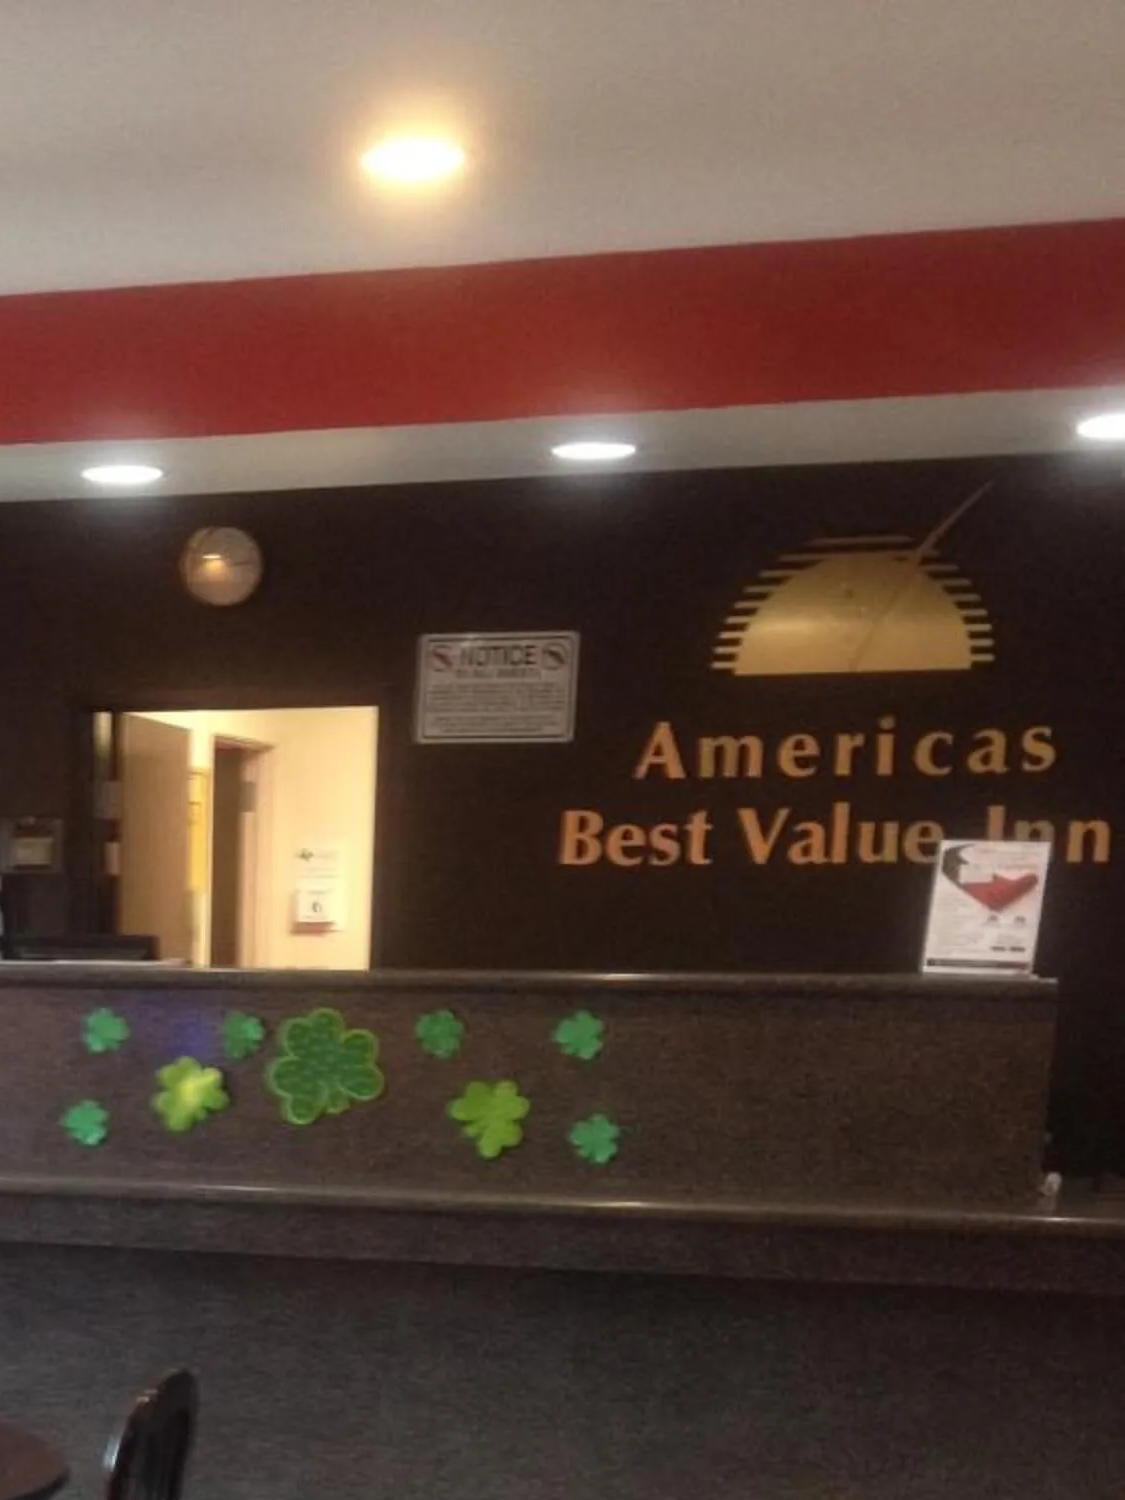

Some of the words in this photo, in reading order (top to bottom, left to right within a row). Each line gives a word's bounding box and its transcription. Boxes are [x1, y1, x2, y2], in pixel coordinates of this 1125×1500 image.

[460, 644, 537, 666] NOTICE
[633, 716, 1057, 780] Americas
[559, 810, 713, 865] Best
[738, 803, 944, 865] Value
